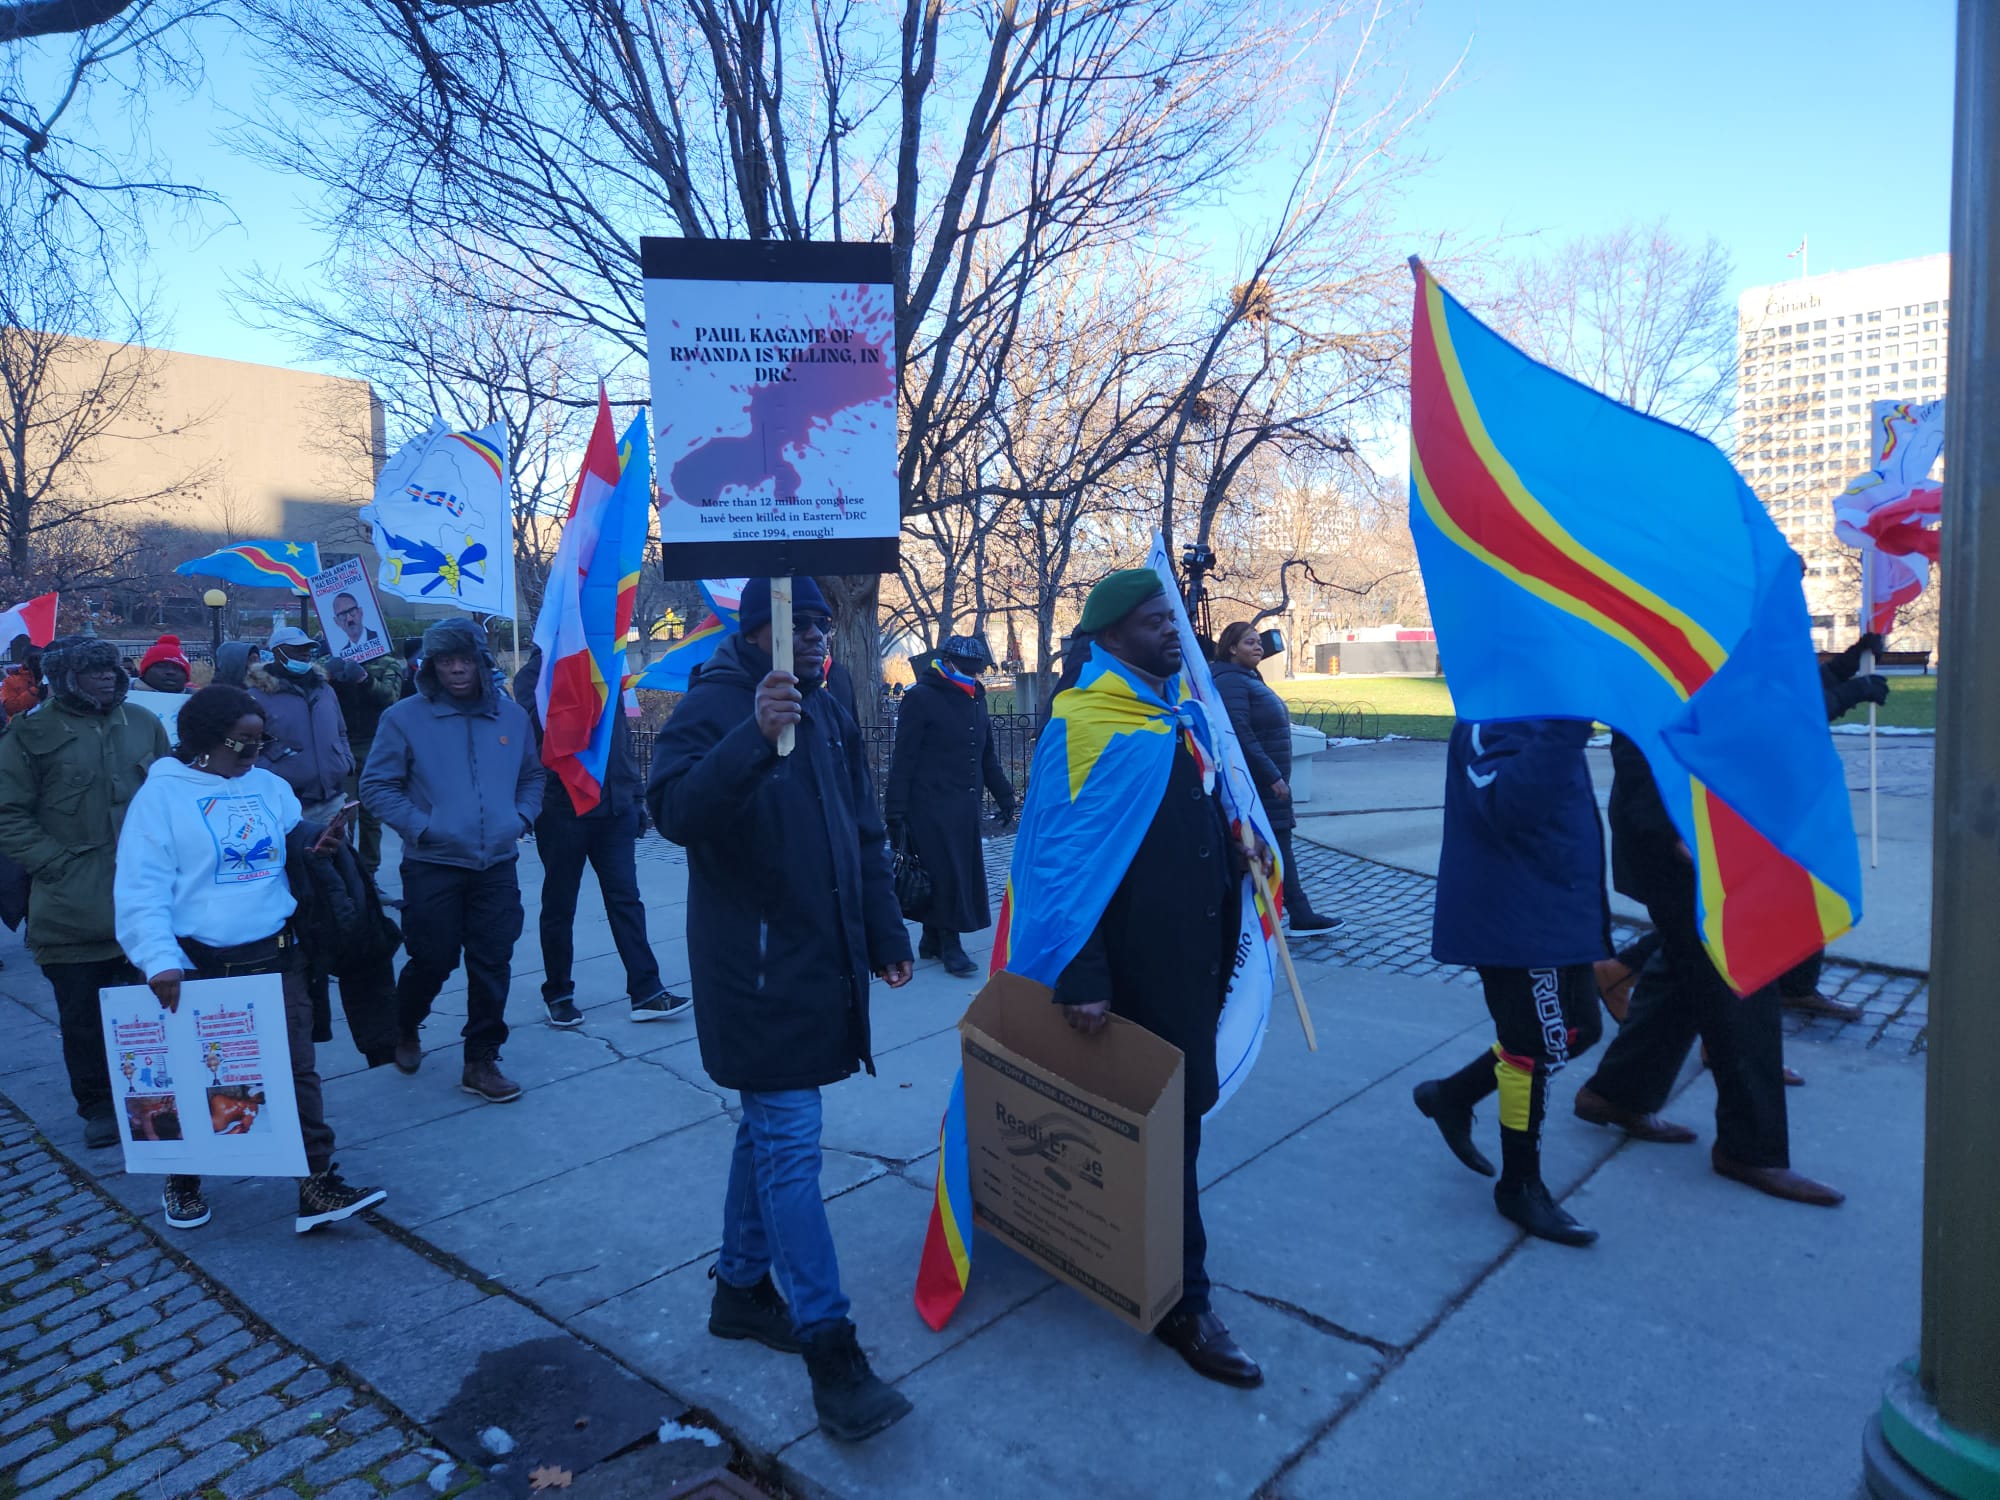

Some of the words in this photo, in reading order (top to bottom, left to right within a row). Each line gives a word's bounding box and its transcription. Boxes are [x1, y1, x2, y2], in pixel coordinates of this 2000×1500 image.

[1765, 292, 1821, 315] Canada
[695, 327, 746, 343] PAUL
[750, 328, 827, 343] KAGAME
[830, 329, 855, 343] OF
[670, 346, 751, 362] RWANDA
[756, 347, 774, 362] IS
[778, 347, 857, 365] KILLING,
[860, 348, 880, 364] IN
[755, 367, 797, 383] DRC.
[701, 498, 730, 508] More
[732, 497, 757, 507] than
[760, 497, 772, 507] 12
[775, 496, 813, 506] million
[816, 496, 864, 508] congolese
[700, 513, 726, 524] have
[728, 512, 753, 523] been
[756, 512, 786, 522] killed
[789, 512, 800, 522] in
[803, 512, 842, 521] Eastern
[844, 511, 867, 520] DRC
[733, 528, 760, 539] since
[762, 528, 790, 539] 1994,
[792, 527, 834, 539] enough!
[344, 573, 363, 586] PEOPLE
[370, 638, 382, 648] THE
[1091, 1107, 1129, 1136] BOARD
